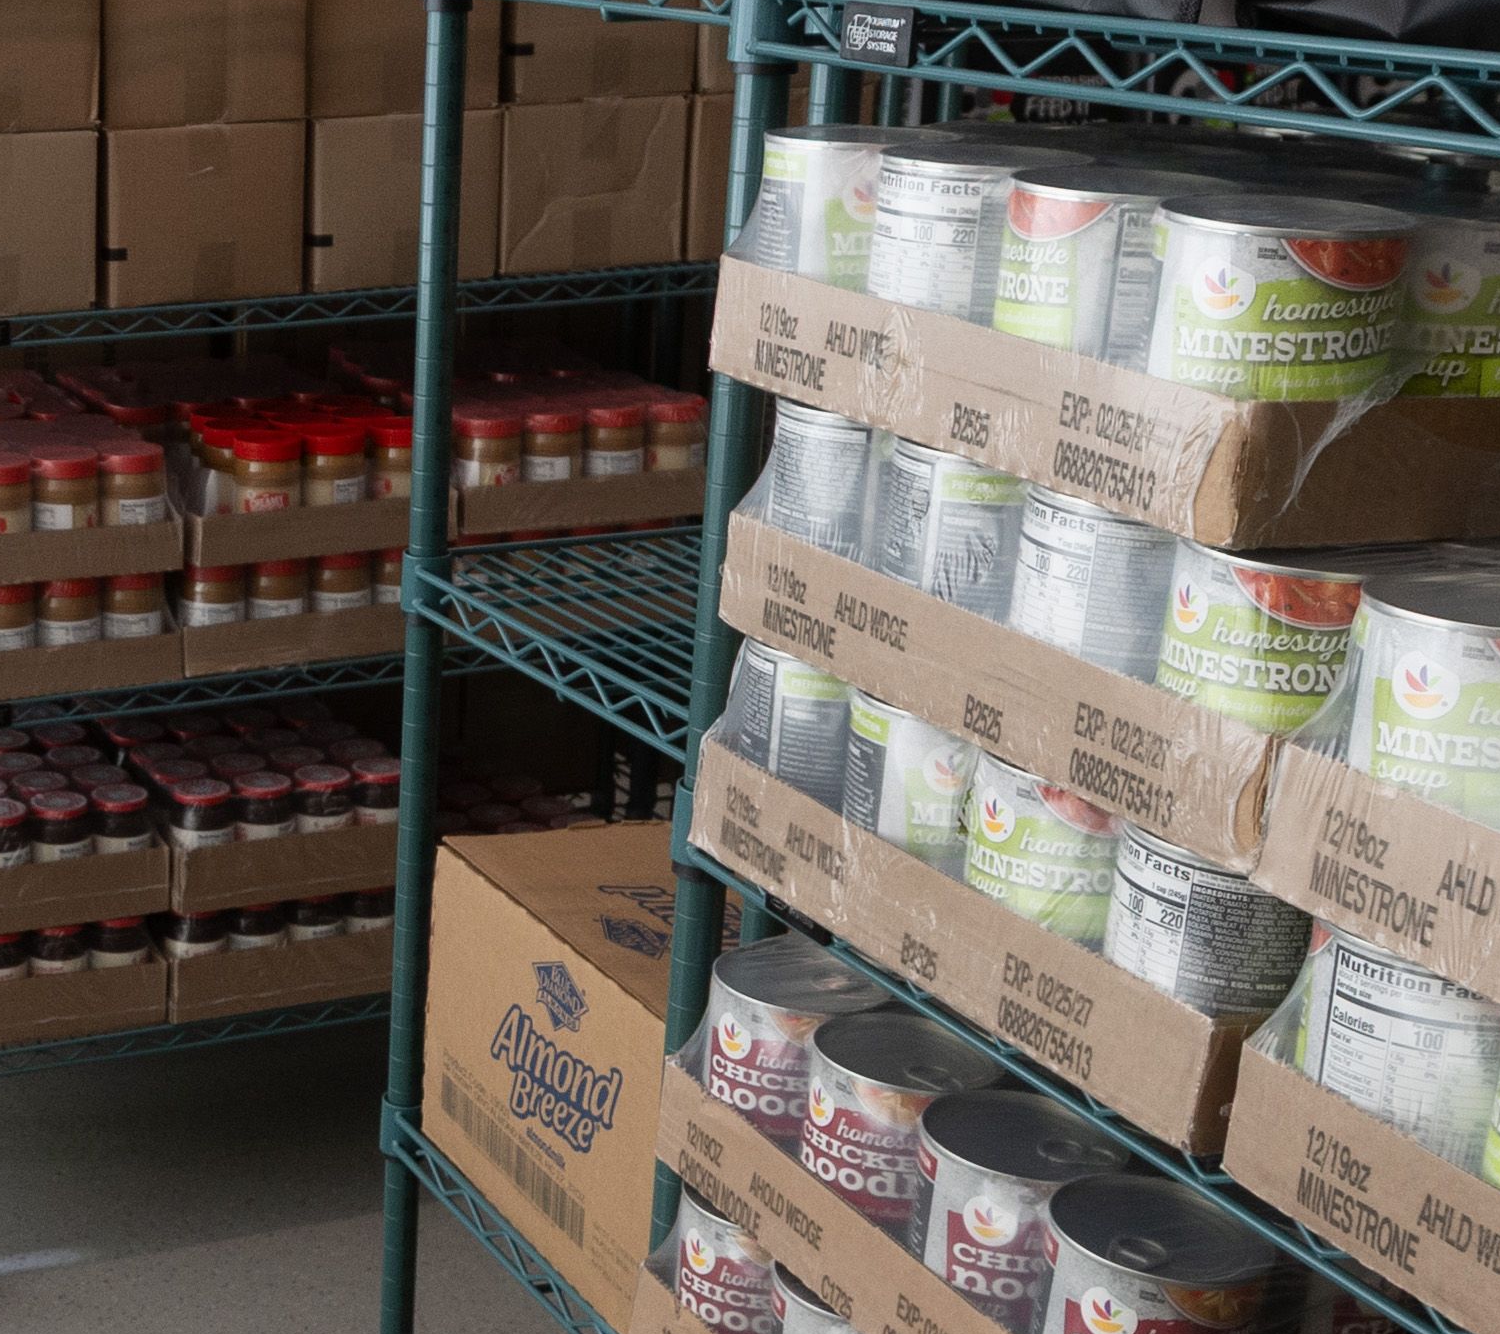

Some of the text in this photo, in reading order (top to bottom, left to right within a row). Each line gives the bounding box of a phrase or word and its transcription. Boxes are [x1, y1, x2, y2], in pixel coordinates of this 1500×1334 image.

[866, 42, 896, 53] SYSTEMS
[869, 29, 898, 41] STORAGE
[930, 180, 981, 197] Facts
[913, 224, 976, 245] 100 220
[759, 302, 858, 358] 12/19oz AHLD
[753, 338, 826, 392] MINESTRONE
[1059, 390, 1092, 436] EXP:
[1053, 438, 1156, 511] 068826755413
[1051, 511, 1096, 533] Facts
[1066, 564, 1089, 583] 220
[761, 598, 836, 660] MINESTRONE
[766, 562, 908, 653] 12/19oz AHLD WDGE
[963, 693, 1003, 744] B2525
[1075, 701, 1106, 746] EXP:
[1068, 748, 1176, 828] 068826755413
[1376, 759, 1452, 791] soup
[719, 817, 788, 887] MINESTRONE
[1144, 854, 1192, 882] Facts
[1321, 806, 1390, 870] 12/19oz
[1436, 859, 1495, 918] AHLD
[1127, 893, 1184, 930] 100 220
[1192, 885, 1250, 902] INGREDIENTS:
[1308, 851, 1437, 947] MINESTRONE
[1002, 951, 1094, 1028] EXP: 02/25/27
[1178, 970, 1226, 987] CONTAINS:
[1339, 950, 1432, 995] Nutrition
[996, 995, 1094, 1081] 068826755413
[1331, 1006, 1376, 1035] Calories
[491, 1003, 623, 1130] Almond
[510, 1070, 596, 1153] Breeze
[677, 1147, 762, 1238] CHICKEN NOODLE
[685, 1119, 823, 1252] 12/19OZ AHOLD WEDGE
[1305, 1125, 1371, 1194] 12/19oz
[1416, 1193, 1473, 1254] AHLD
[1296, 1167, 1420, 1275] MINESTRONE
[820, 1275, 854, 1318] C1725
